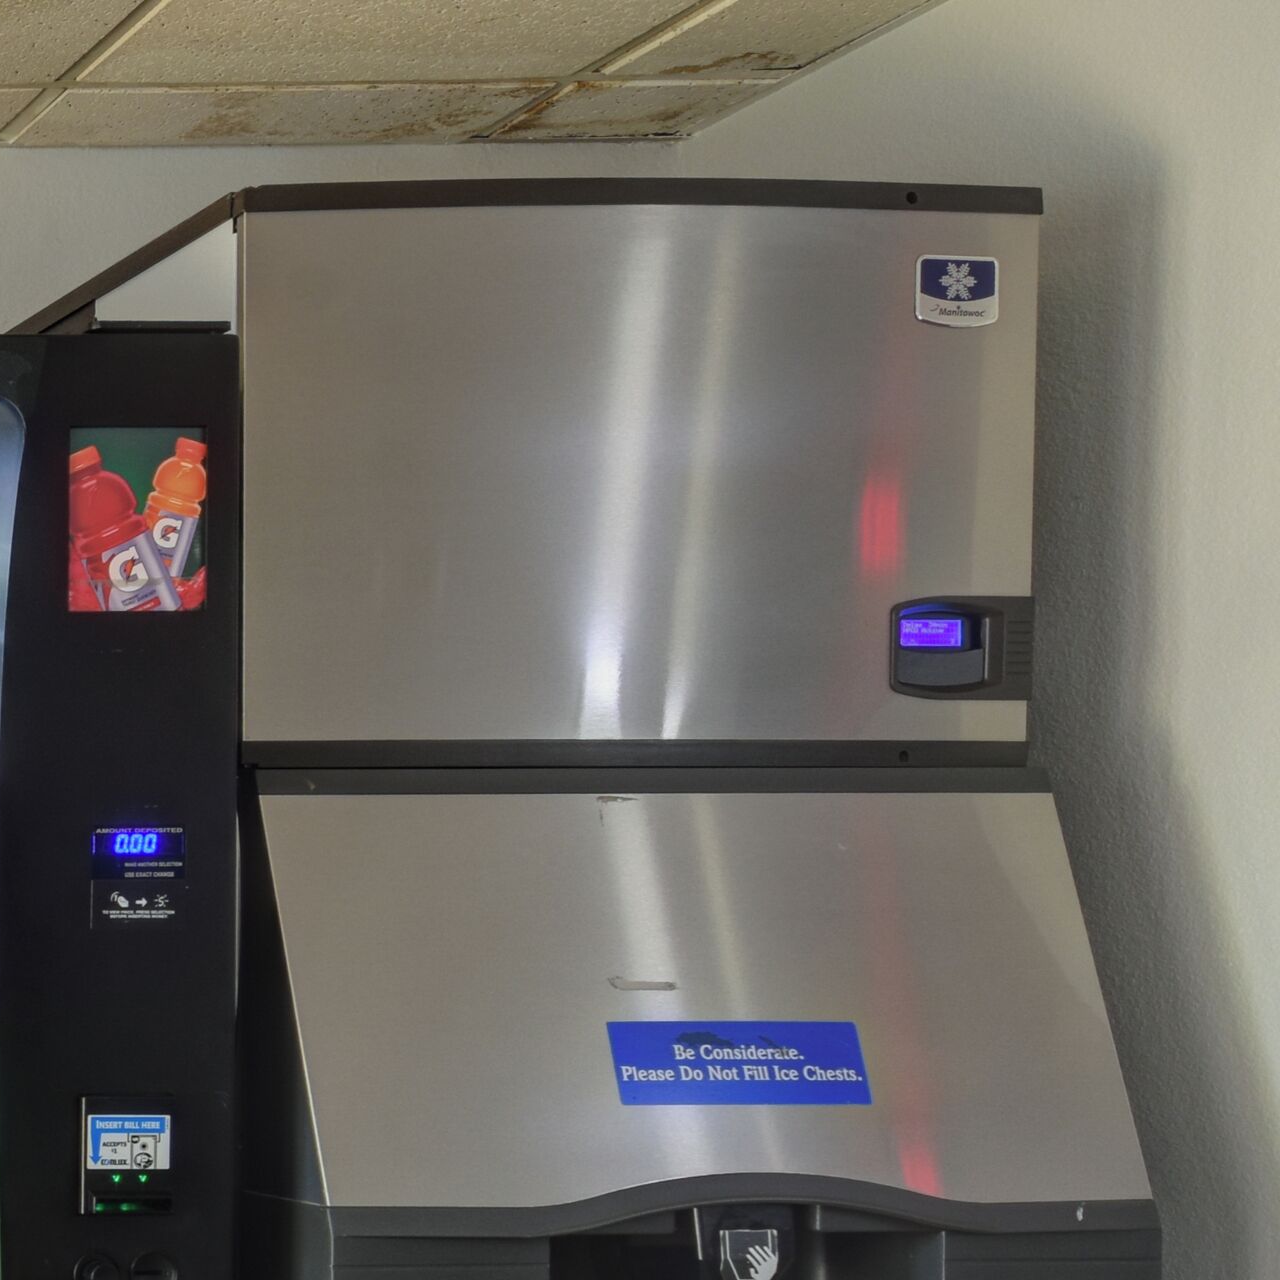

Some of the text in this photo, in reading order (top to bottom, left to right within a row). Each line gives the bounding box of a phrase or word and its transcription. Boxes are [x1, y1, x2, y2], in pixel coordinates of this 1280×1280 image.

[938, 305, 986, 318] Manitowoc
[673, 1044, 804, 1060] Be Considerate.
[620, 1065, 863, 1082] Please Do Not Fill Ice Chests.
[95, 1120, 161, 1129] INSERT BILL HERE
